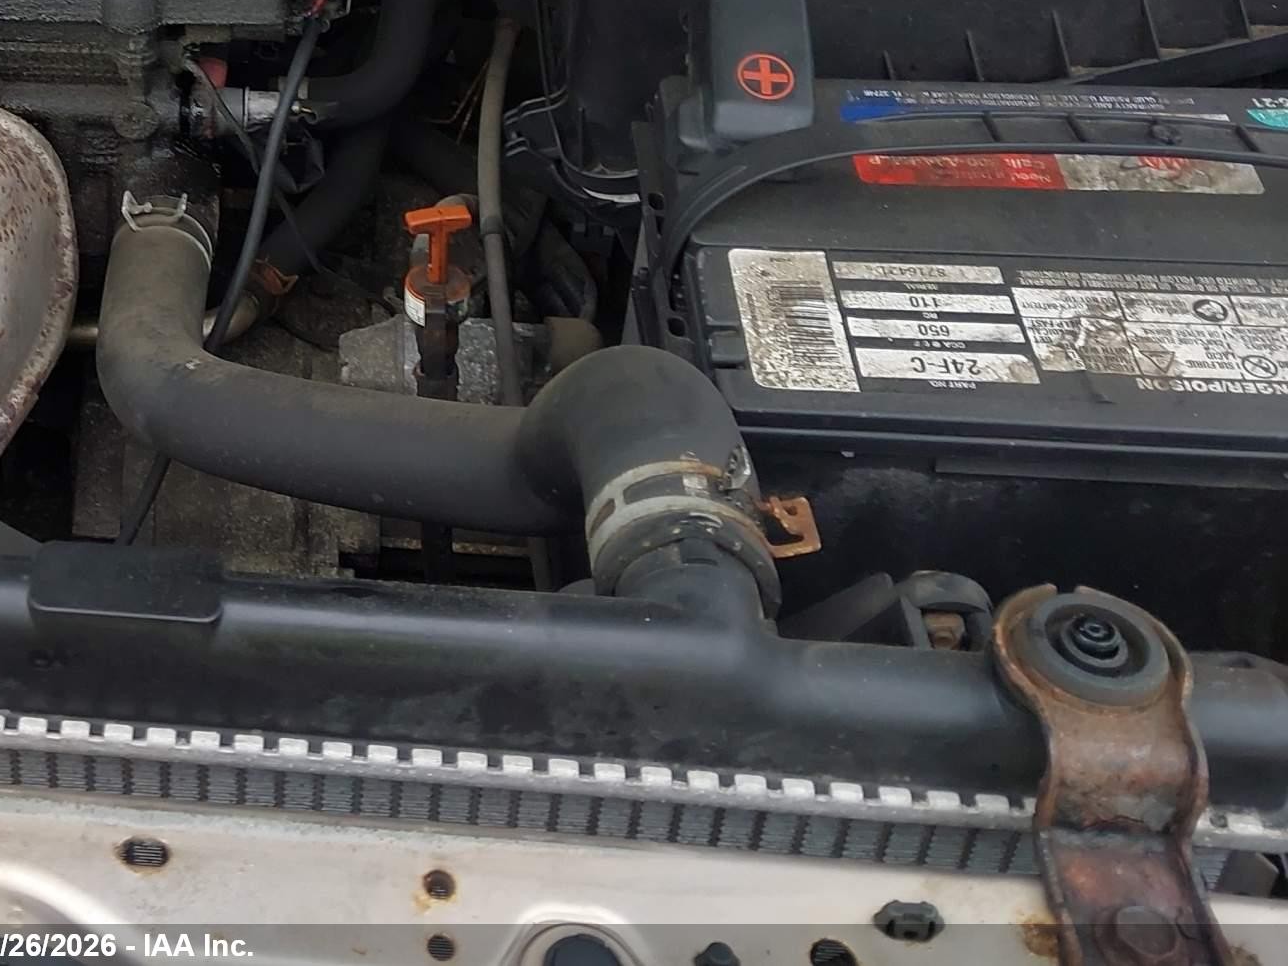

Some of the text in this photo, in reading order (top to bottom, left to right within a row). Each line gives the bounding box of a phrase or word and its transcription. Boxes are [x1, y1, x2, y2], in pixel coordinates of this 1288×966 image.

[909, 295, 940, 309] 110
[918, 324, 950, 337] 650
[942, 341, 966, 349] CCA
[910, 357, 981, 375] 24F-C
[1185, 360, 1234, 370] SULFURIC
[947, 381, 976, 389] PART
